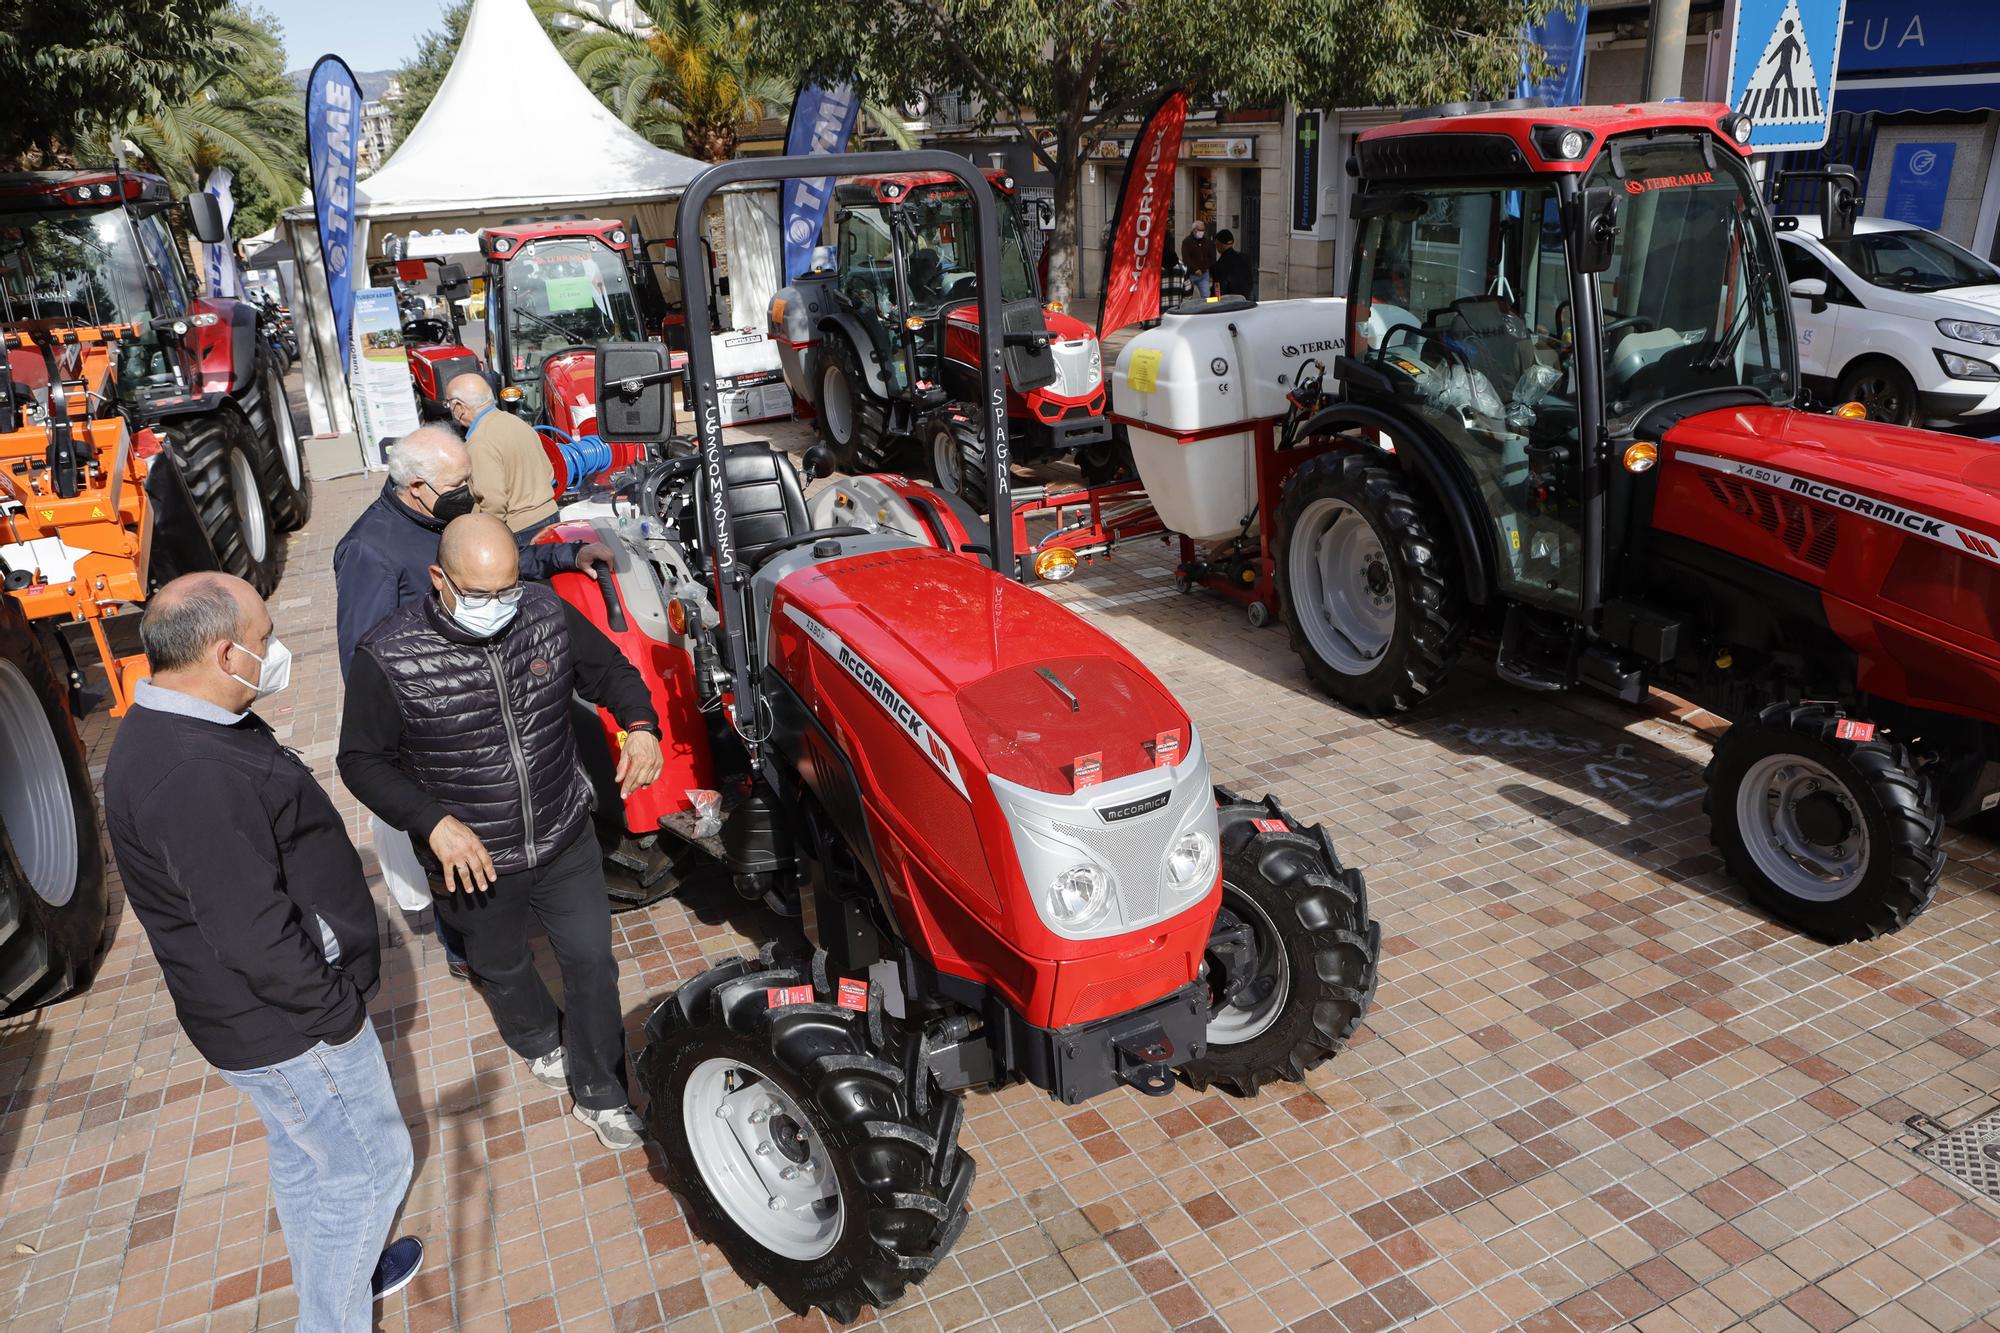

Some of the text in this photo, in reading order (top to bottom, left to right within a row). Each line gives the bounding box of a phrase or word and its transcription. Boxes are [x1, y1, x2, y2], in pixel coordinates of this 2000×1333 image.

[326, 79, 351, 232] TEYME
[1643, 171, 1713, 190] TERRAMAR
[991, 388, 1008, 495] SPAGNA
[1736, 464, 1771, 483] X4.50
